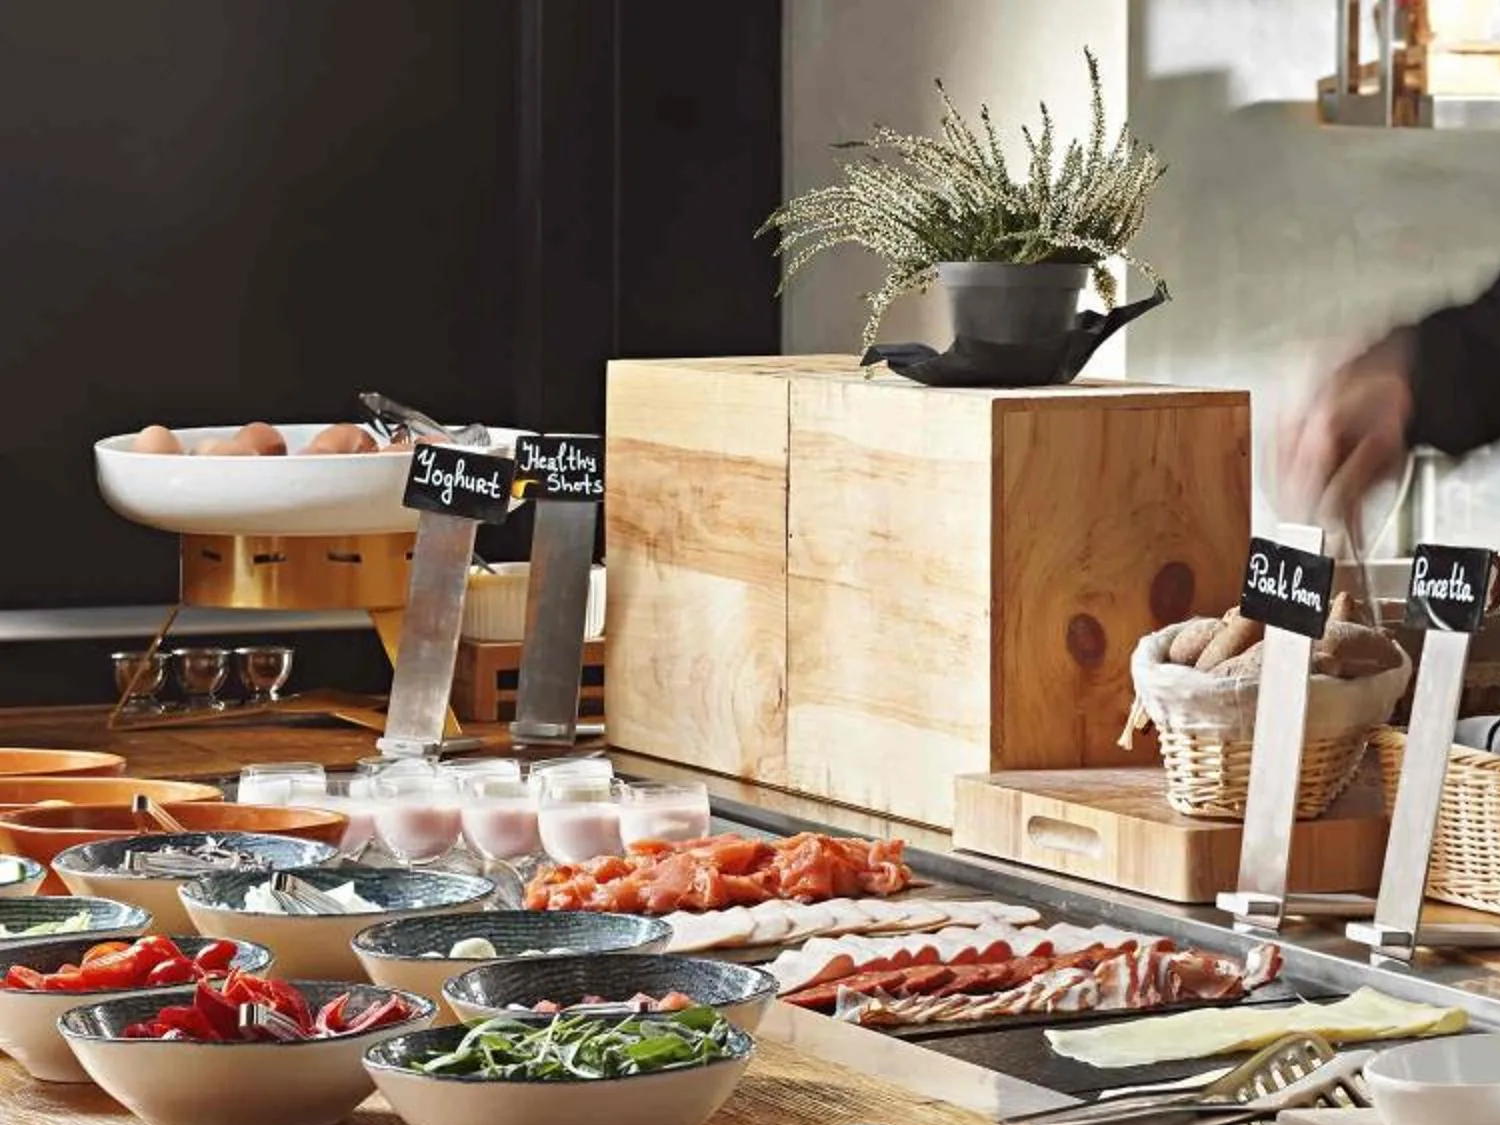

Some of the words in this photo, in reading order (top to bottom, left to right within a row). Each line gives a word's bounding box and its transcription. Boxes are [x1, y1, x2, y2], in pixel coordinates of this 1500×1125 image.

[414, 448, 501, 505] Yoghurt
[521, 442, 597, 472] Healthy
[547, 473, 604, 495] Shots
[1247, 553, 1289, 600] Pork
[1291, 565, 1323, 612] ham
